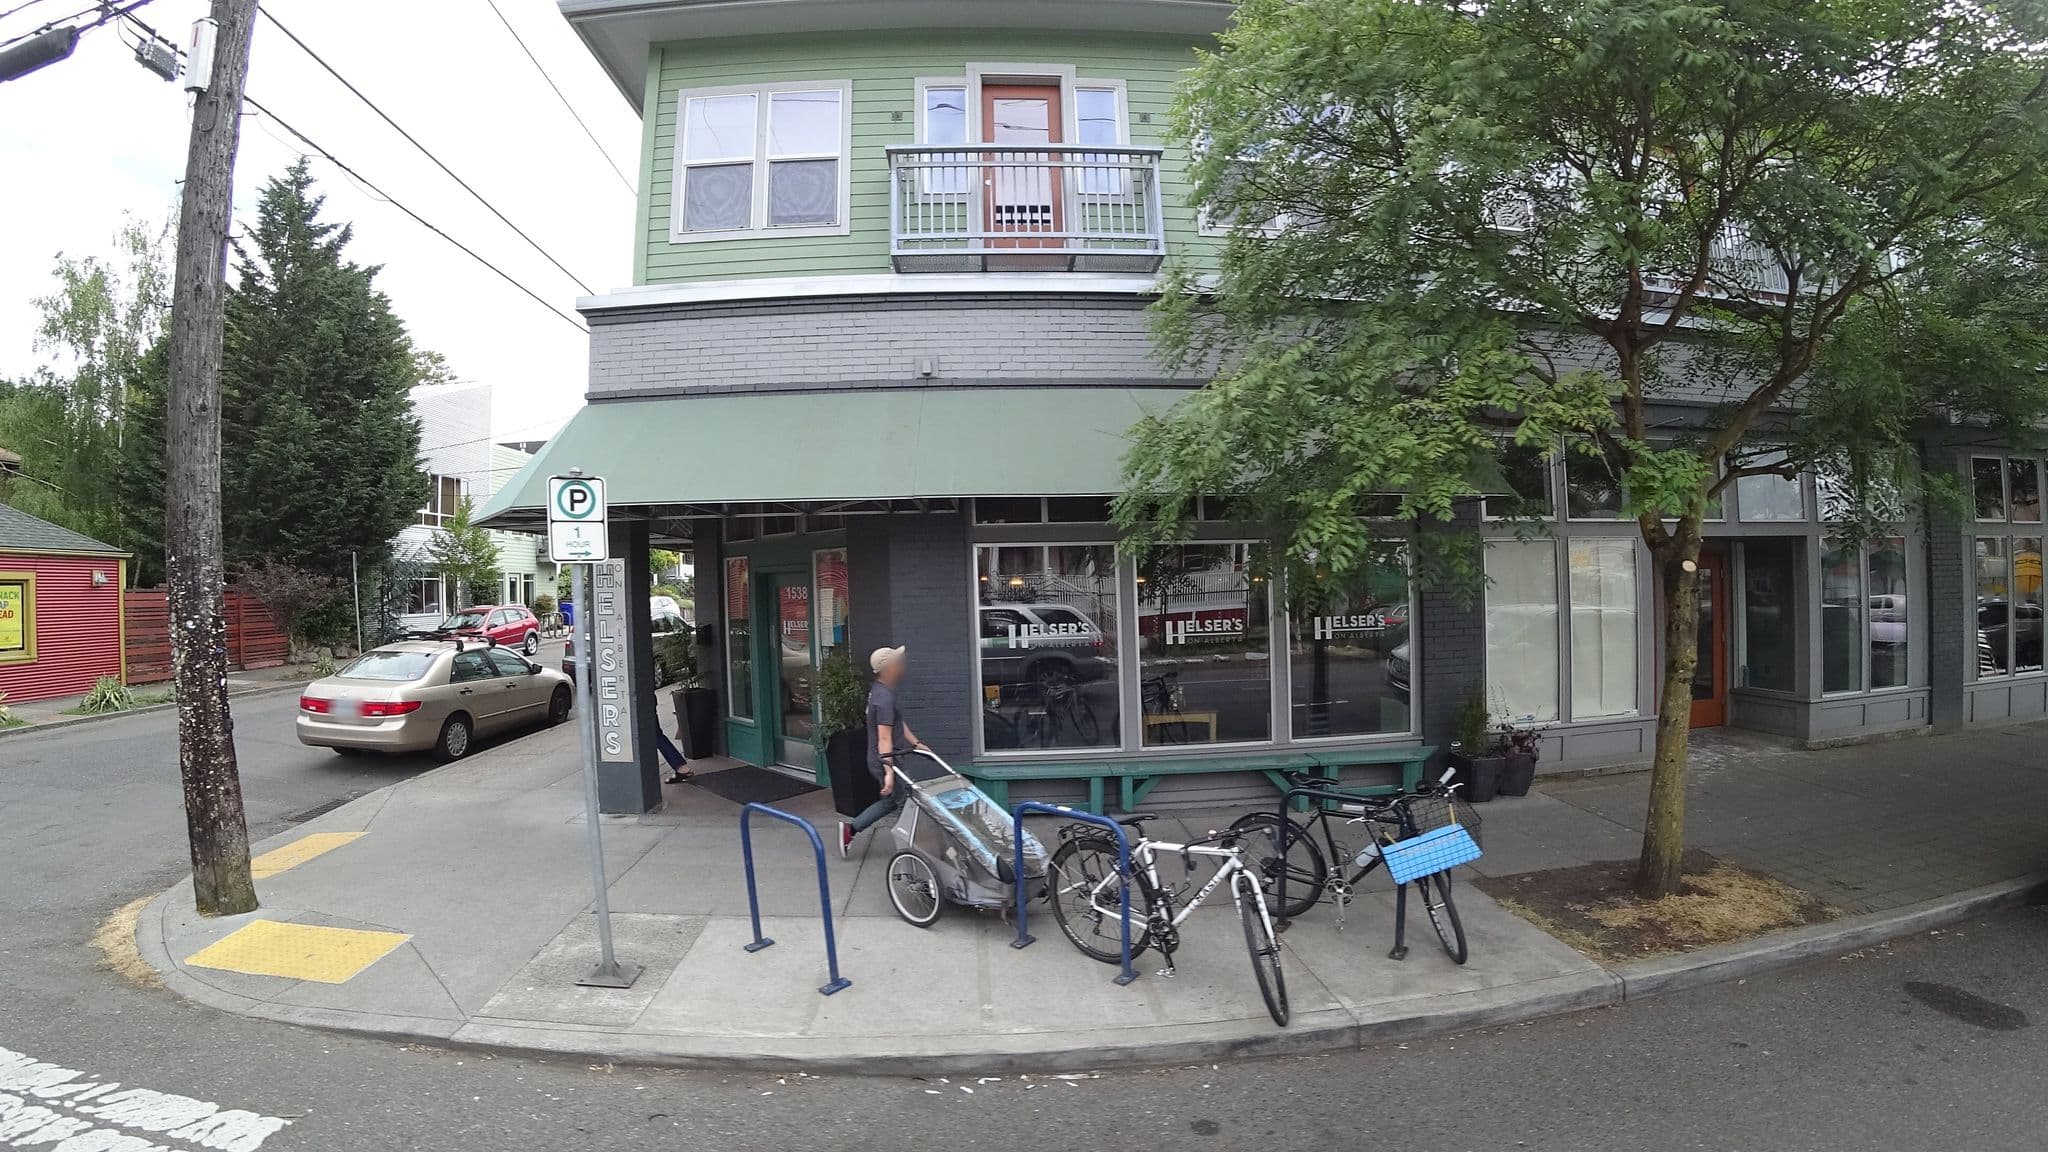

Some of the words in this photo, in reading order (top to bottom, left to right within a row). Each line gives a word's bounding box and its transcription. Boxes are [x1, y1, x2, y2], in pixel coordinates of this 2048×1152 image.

[569, 488, 588, 512] P
[565, 540, 591, 548] HOUR
[574, 526, 580, 538] 1
[784, 586, 809, 600] 1538
[1008, 621, 1090, 649] HELSER'S
[1165, 618, 1243, 645] HELSER'S
[1314, 613, 1385, 640] HELSER'S
